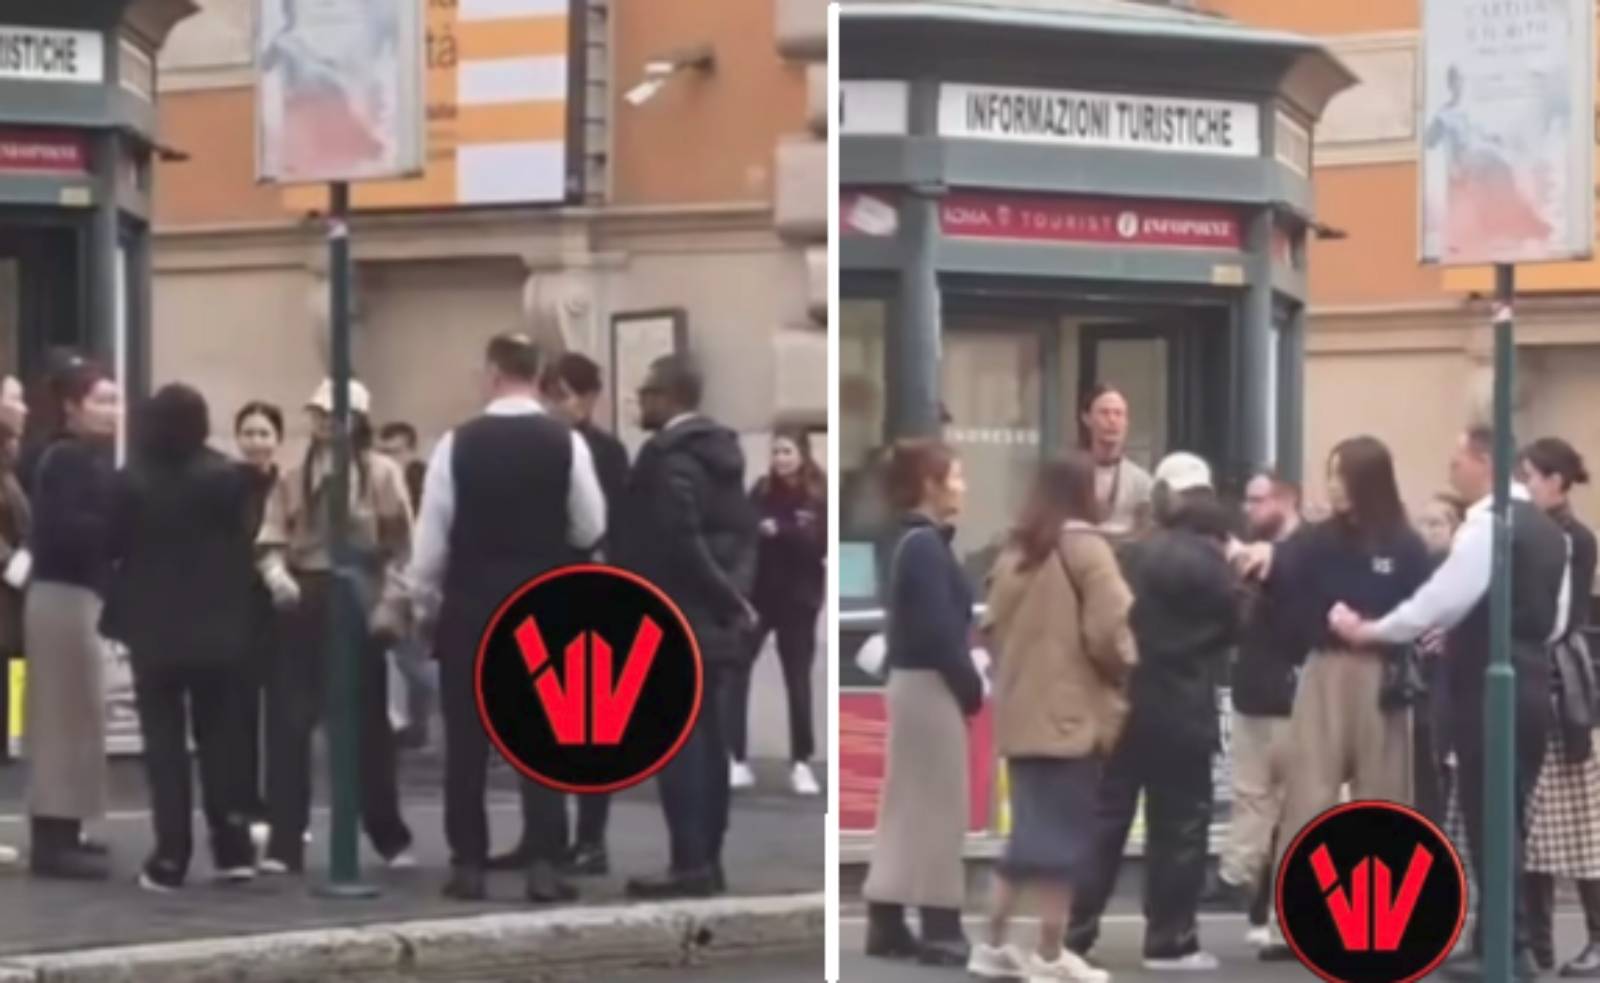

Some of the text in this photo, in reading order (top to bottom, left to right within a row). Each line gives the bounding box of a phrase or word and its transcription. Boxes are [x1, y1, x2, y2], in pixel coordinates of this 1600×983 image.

[966, 91, 1233, 147] INFORMAZIONI TURISTICHE
[1020, 210, 1112, 233] TOURIST
[1143, 216, 1230, 237] INFOPOINT
